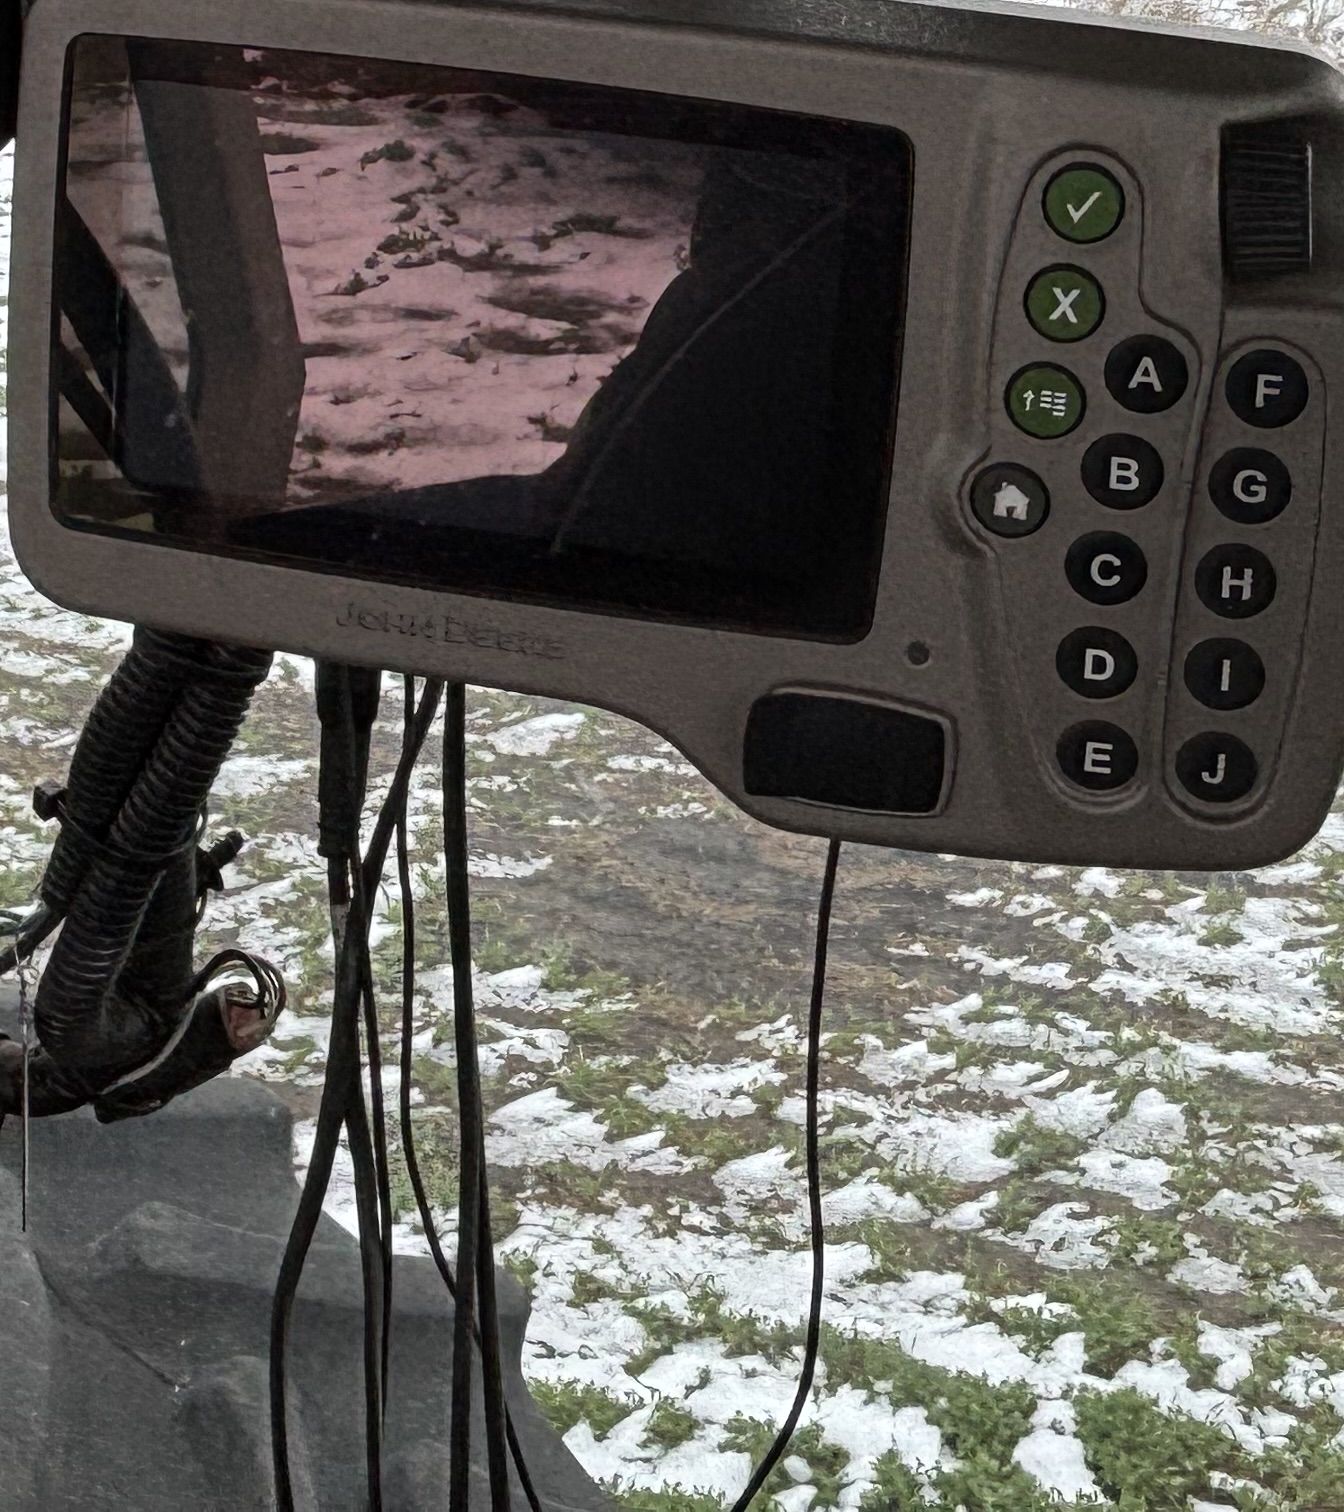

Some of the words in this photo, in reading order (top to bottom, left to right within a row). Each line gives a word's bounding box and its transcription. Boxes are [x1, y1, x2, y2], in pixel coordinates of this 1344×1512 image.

[1129, 357, 1161, 391] A
[1256, 375, 1282, 407] F
[1110, 457, 1139, 490] B
[1234, 470, 1266, 502] G
[1091, 554, 1121, 586] C
[1222, 567, 1252, 600] H
[1084, 649, 1114, 680] D
[1221, 660, 1230, 690] I
[1084, 742, 1112, 773] E
[1202, 754, 1225, 783] J
